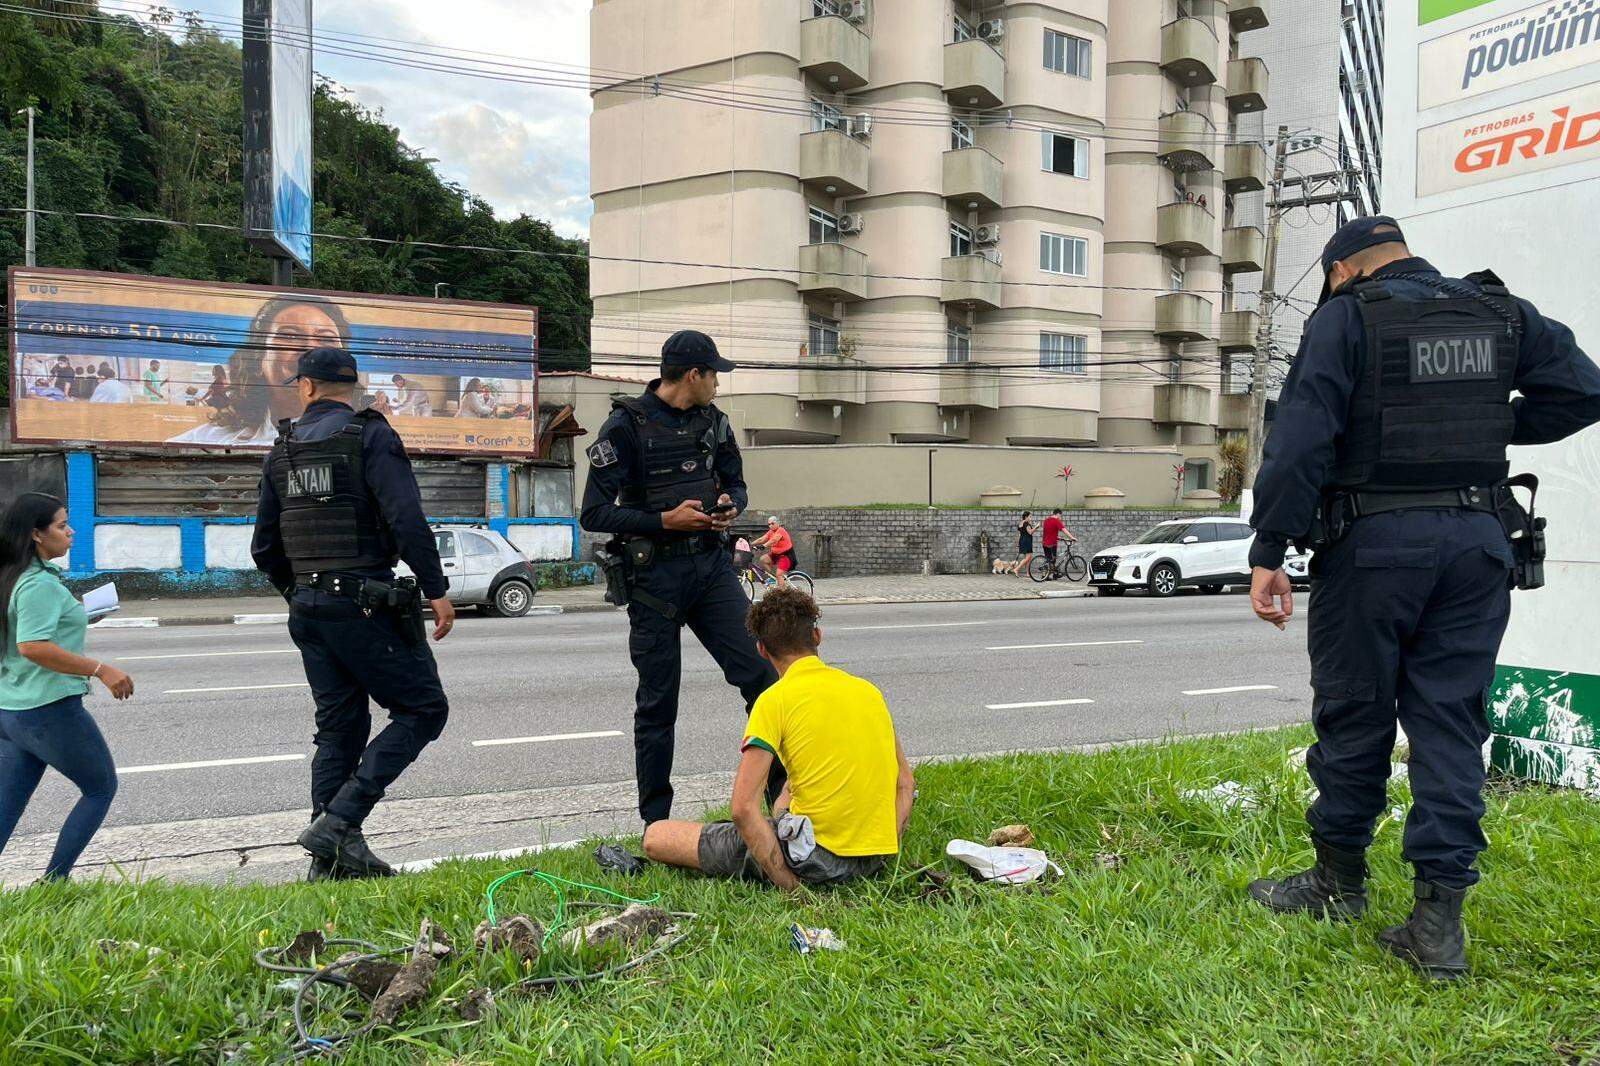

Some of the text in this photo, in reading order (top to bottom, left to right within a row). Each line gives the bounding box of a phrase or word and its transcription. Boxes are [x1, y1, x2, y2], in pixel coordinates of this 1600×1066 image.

[1469, 16, 1526, 41] PETROBRAS
[1461, 9, 1600, 90] podium
[1464, 112, 1535, 138] PETROBRAS
[1416, 338, 1492, 376] ROTAM
[287, 467, 331, 495] ROTAM
